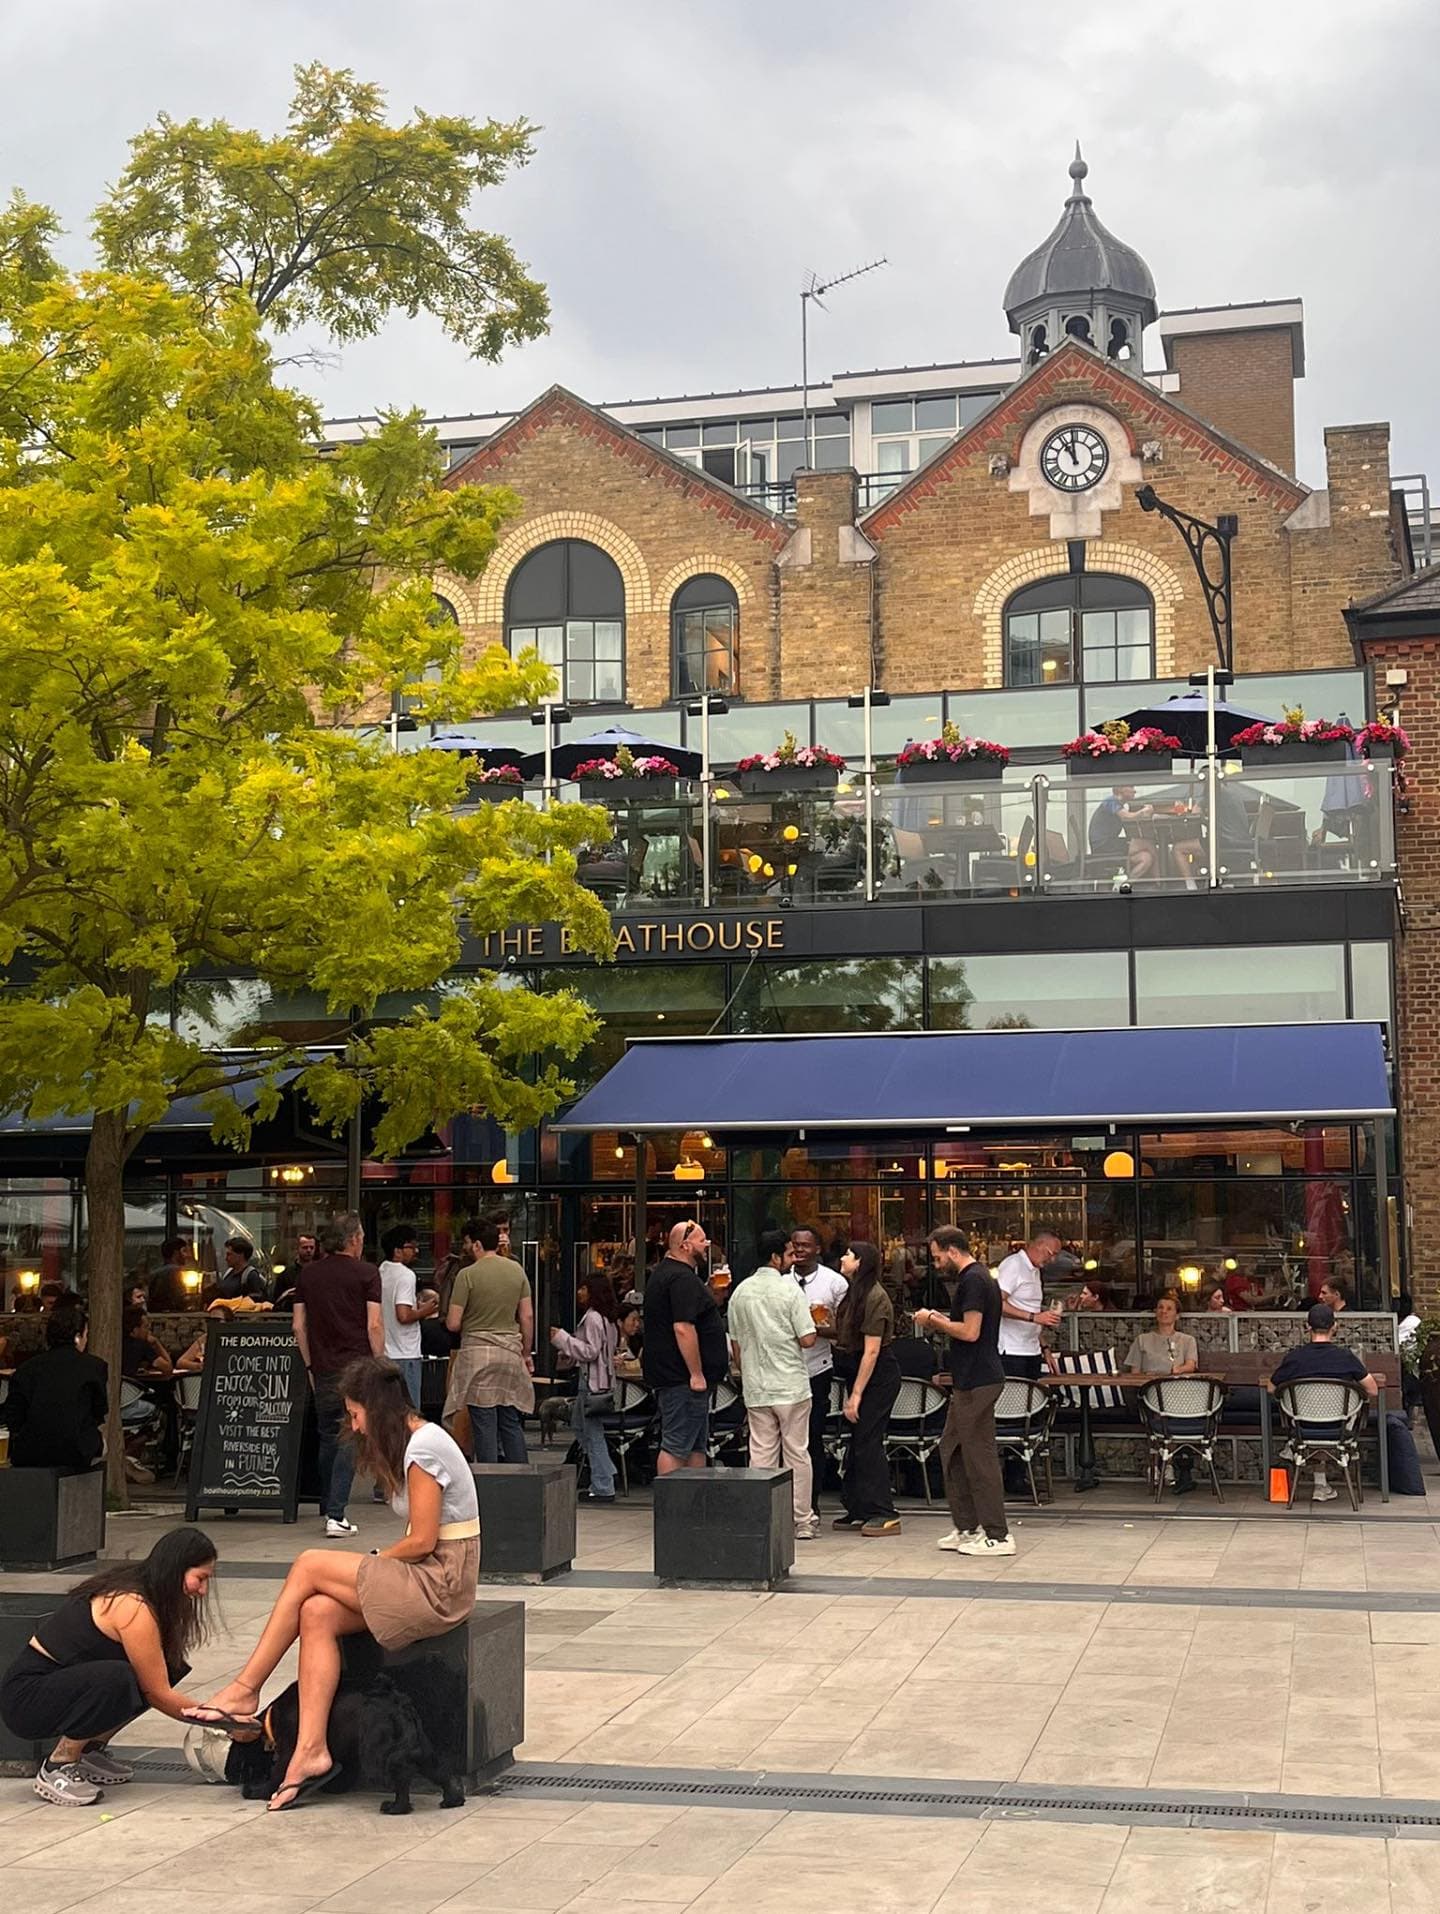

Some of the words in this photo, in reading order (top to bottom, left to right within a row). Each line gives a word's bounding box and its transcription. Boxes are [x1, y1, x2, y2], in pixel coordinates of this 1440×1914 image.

[482, 927, 544, 957] THE
[560, 919, 785, 956] BATHOUSE
[220, 1336, 239, 1347] THE
[240, 1336, 300, 1347] BOATHOUSE
[228, 1354, 263, 1374] COME
[215, 1375, 253, 1393] ENJOY
[258, 1373, 290, 1400] SUN
[218, 1424, 244, 1437] VISIT
[245, 1425, 260, 1437] THE
[260, 1426, 281, 1438] BEST
[223, 1441, 261, 1453] RIVERSIDE
[262, 1442, 278, 1455] PUB
[224, 1459, 235, 1469] IN
[238, 1454, 281, 1474] PUTNEY
[203, 1487, 281, 1496] boathouseputney.co.uk
